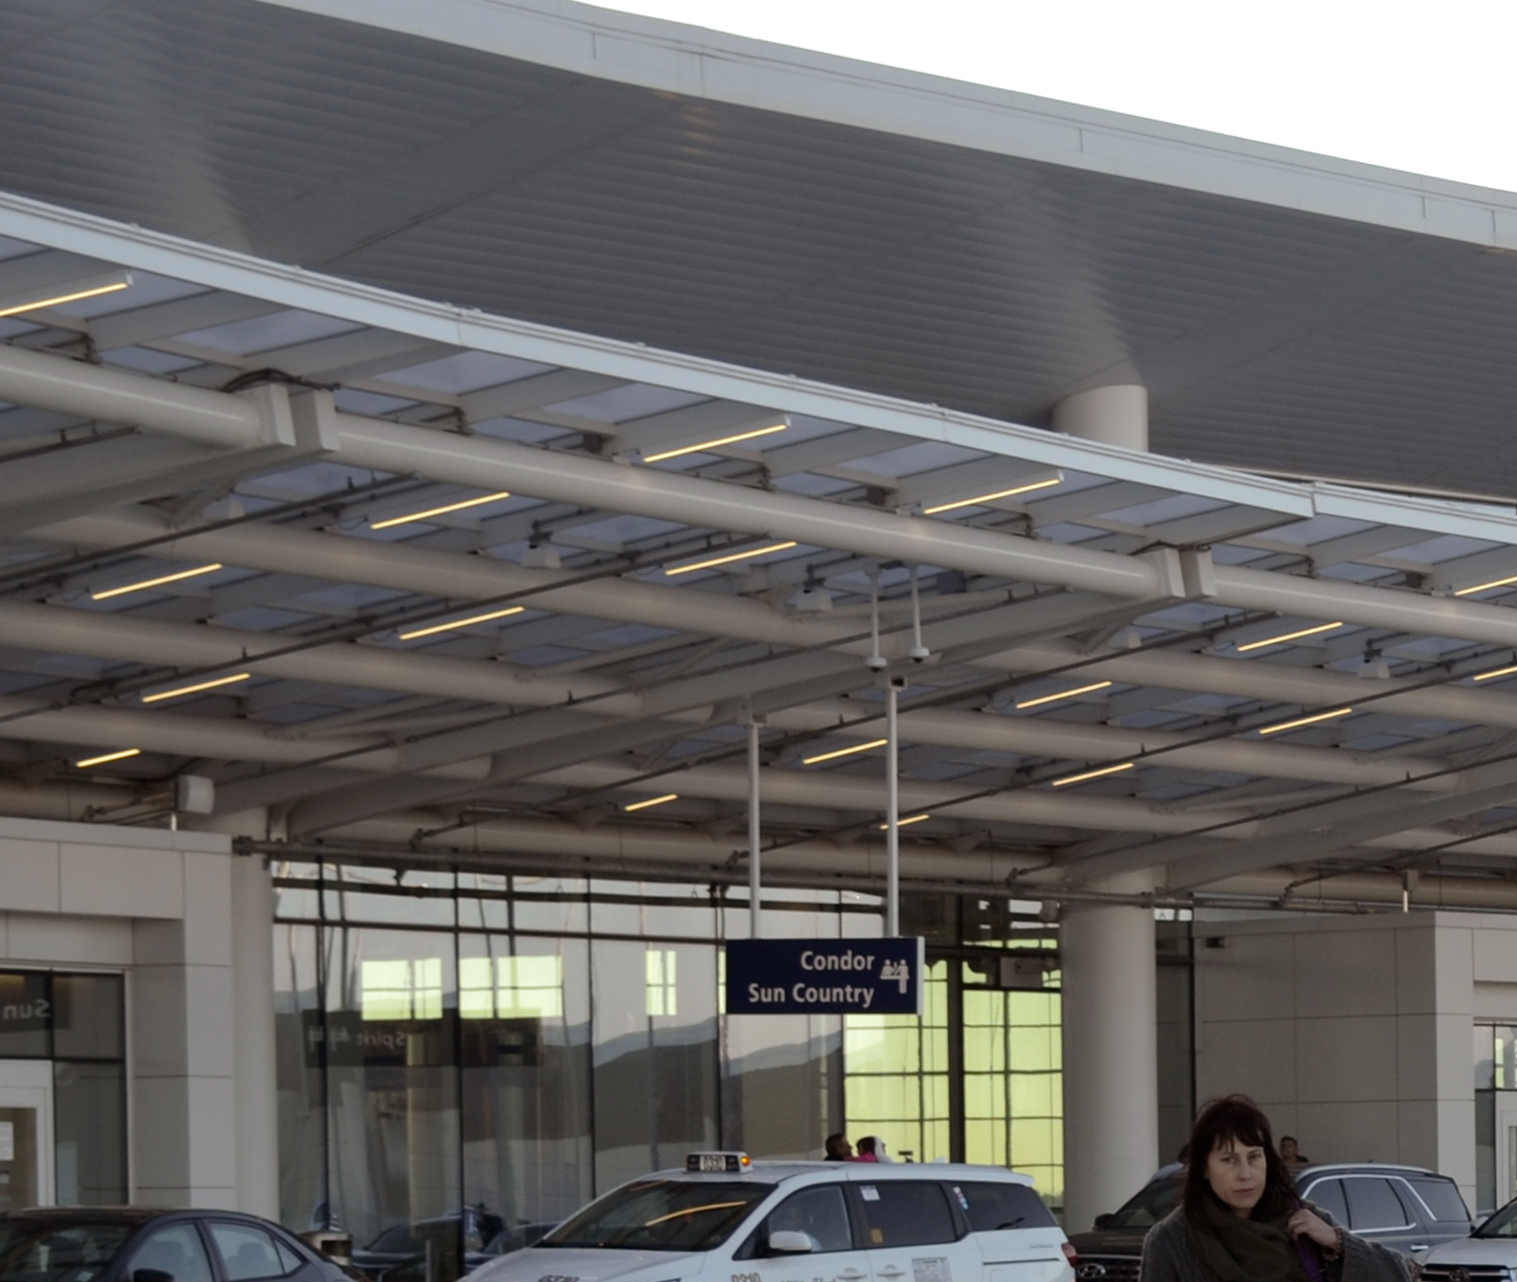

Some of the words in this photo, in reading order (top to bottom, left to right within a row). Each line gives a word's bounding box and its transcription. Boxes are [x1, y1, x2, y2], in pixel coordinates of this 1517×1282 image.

[801, 950, 875, 971] Condor
[748, 983, 786, 1004] Sun
[792, 983, 875, 1009] Country
